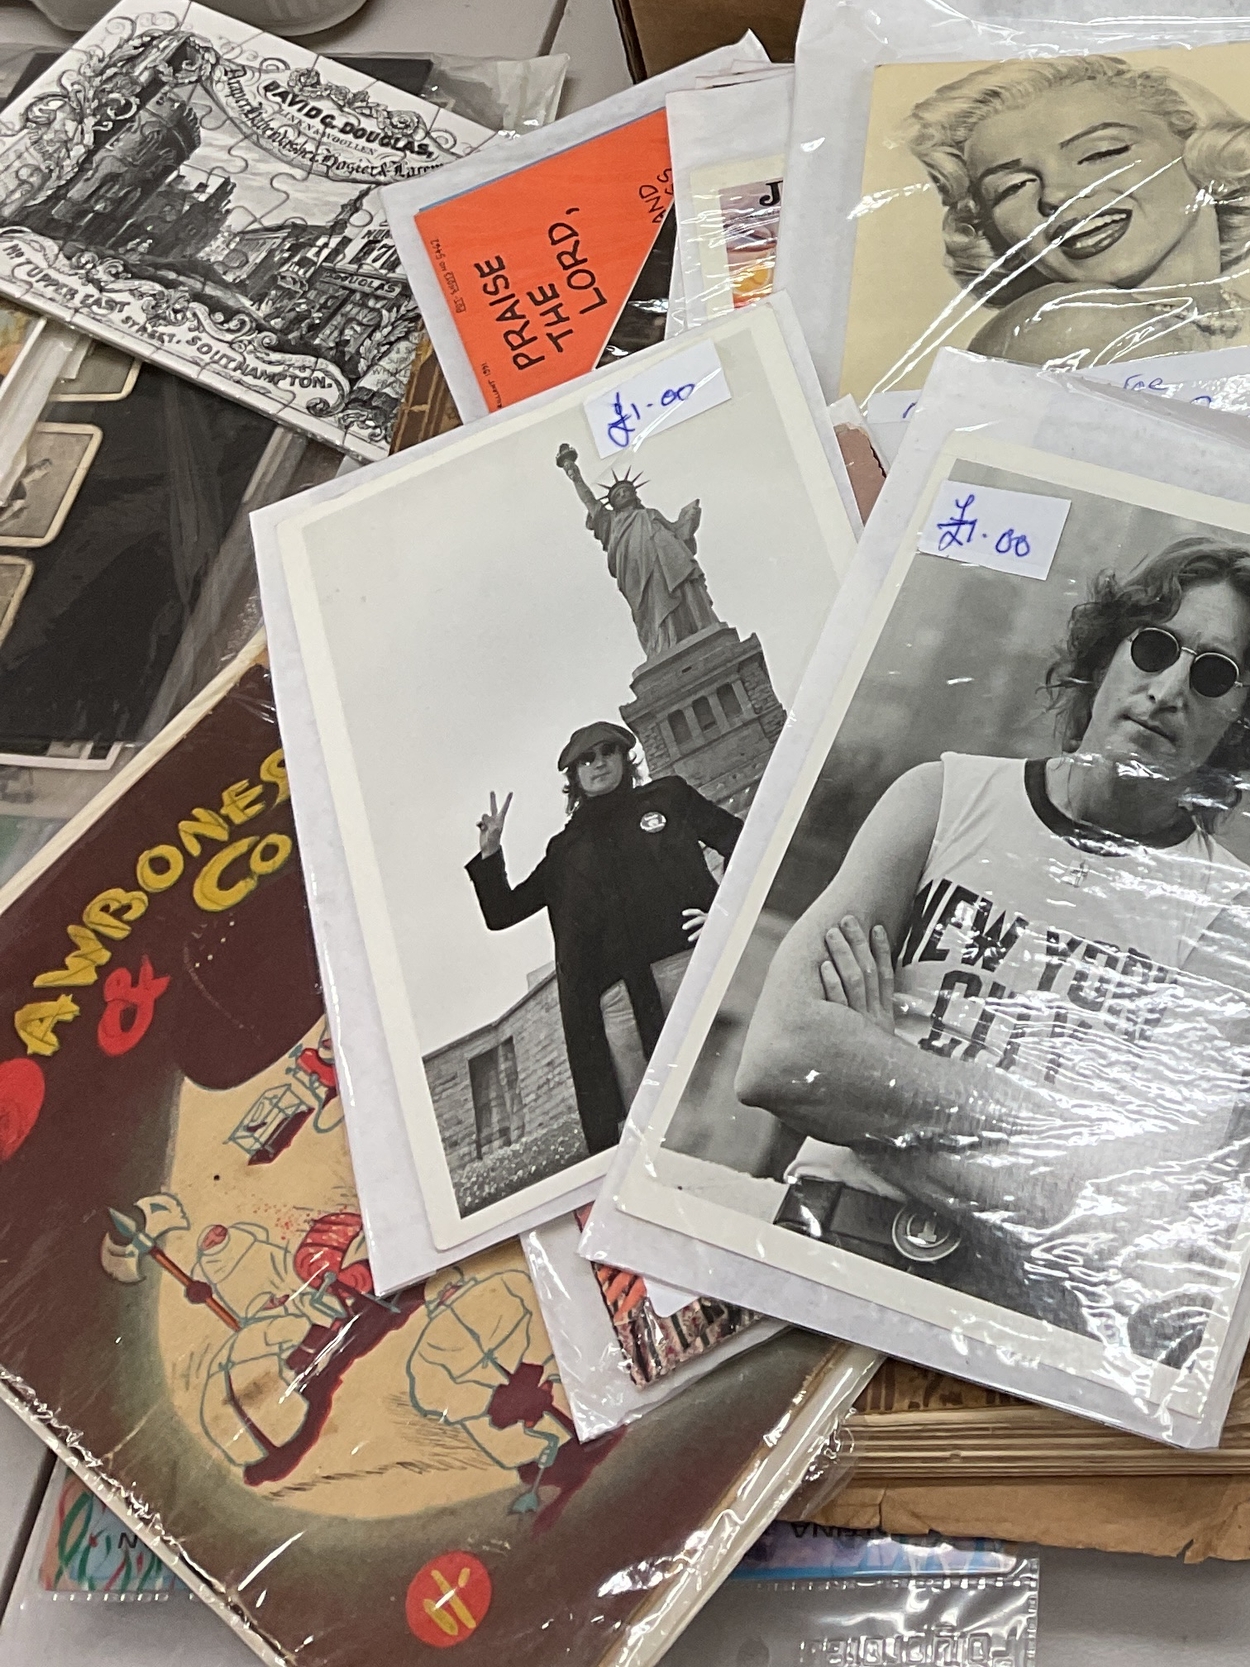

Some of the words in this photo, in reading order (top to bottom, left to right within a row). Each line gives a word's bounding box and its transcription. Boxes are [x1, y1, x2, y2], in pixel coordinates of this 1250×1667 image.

[261, 80, 323, 120] DAVID
[338, 119, 435, 159] DOUGLAS,
[473, 254, 546, 371] PRAISE
[546, 206, 609, 316] LORD,
[26, 266, 80, 302] UPPER
[79, 292, 131, 314] EAST
[186, 335, 333, 390] SOUTHAMPTON.
[525, 282, 575, 354] THE
[902, 877, 1031, 974] NEW
